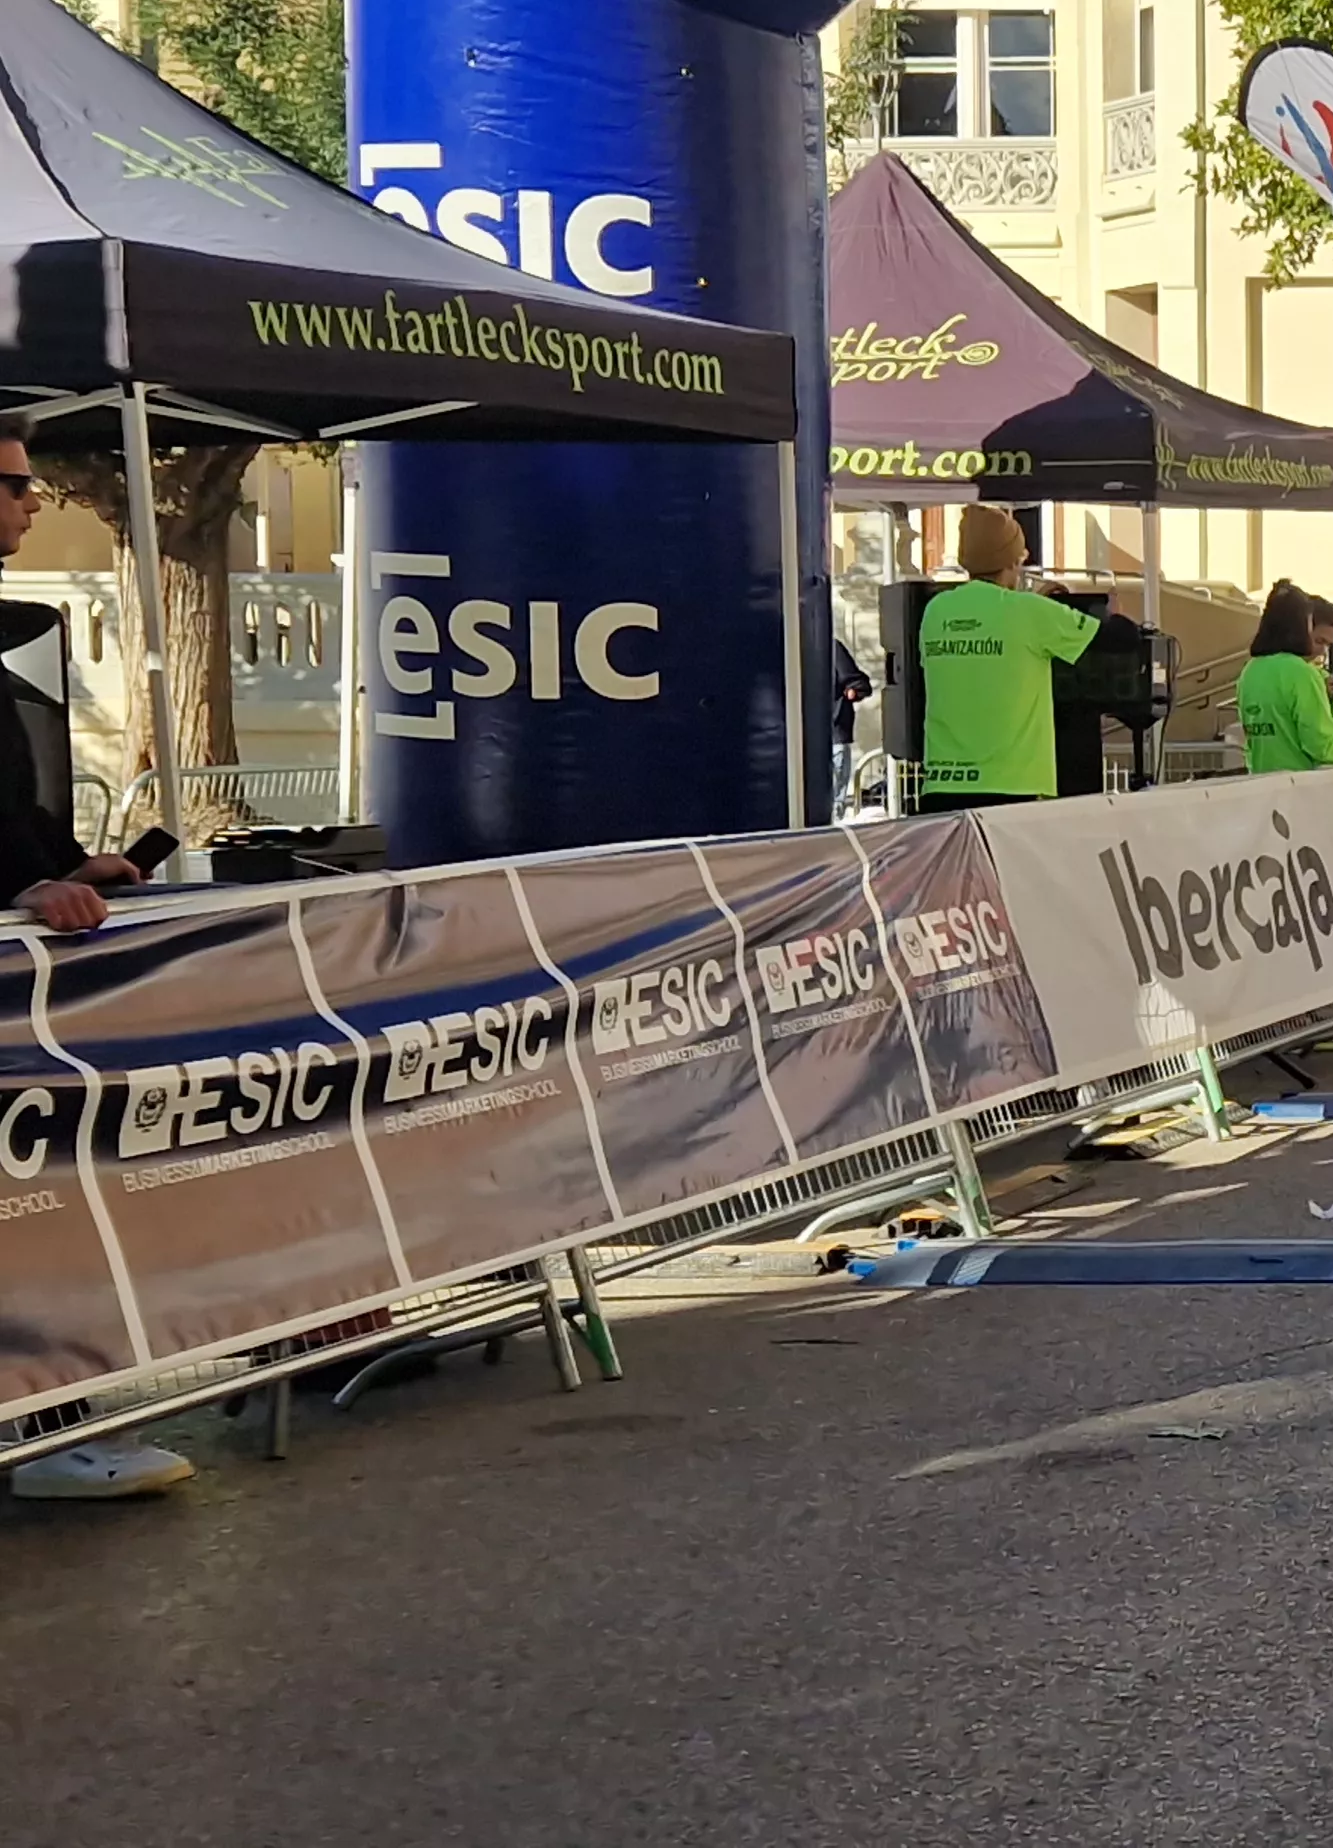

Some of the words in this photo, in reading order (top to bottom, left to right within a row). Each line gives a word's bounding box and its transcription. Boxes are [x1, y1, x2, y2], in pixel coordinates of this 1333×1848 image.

[247, 290, 725, 395] www.fartlecksport.com
[786, 928, 876, 1007] ESIC
[922, 901, 1008, 974] ESIC
[429, 996, 553, 1093] ESIC
[632, 958, 731, 1045] ESIC
[178, 1042, 338, 1147] ESIC
